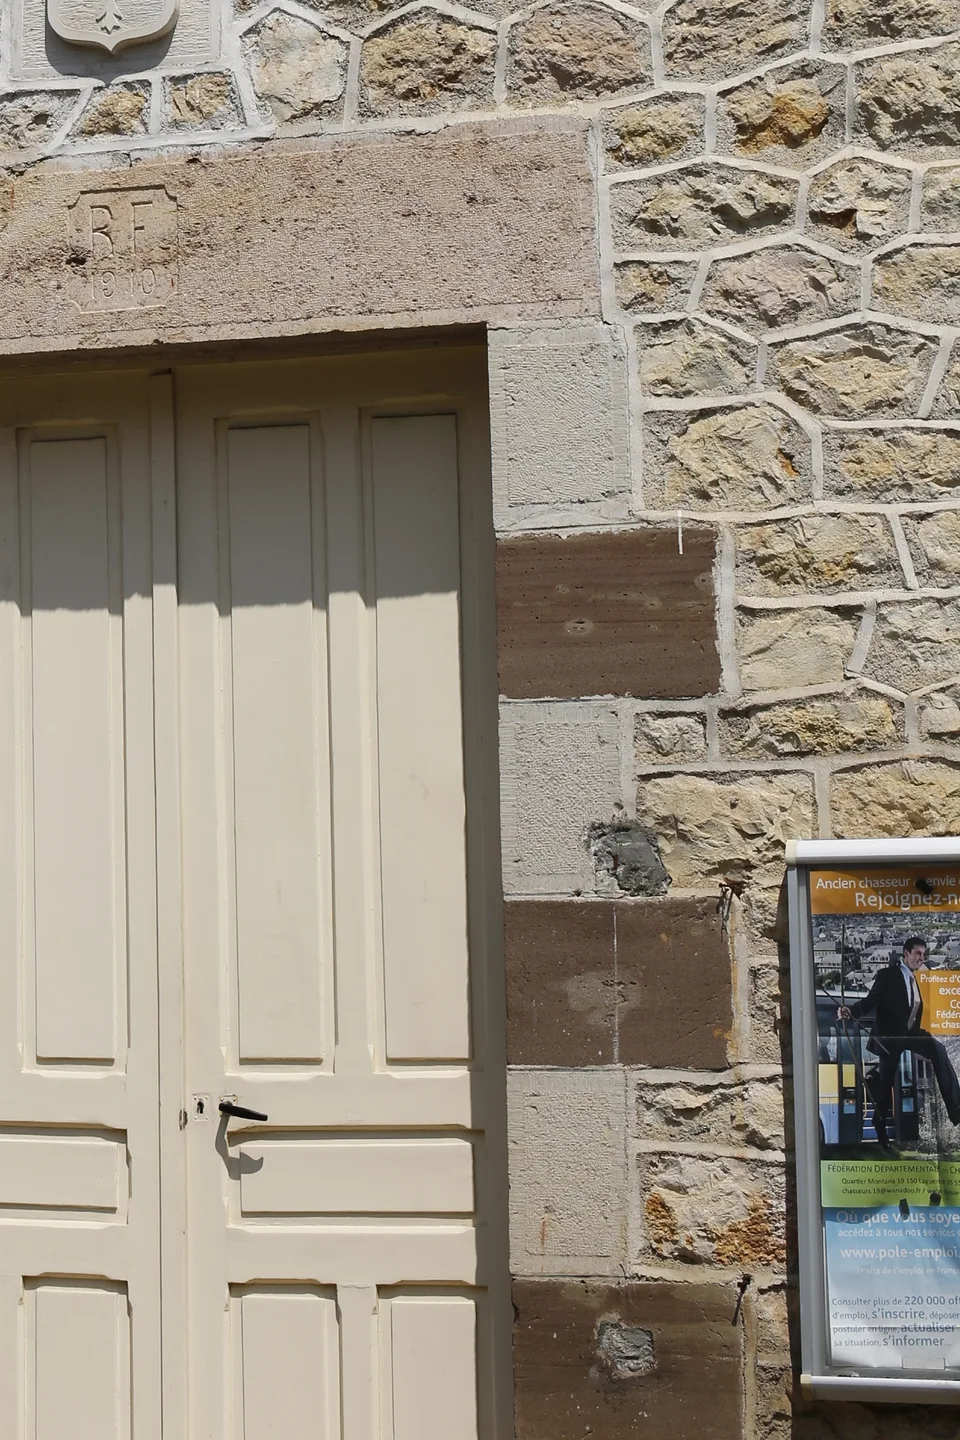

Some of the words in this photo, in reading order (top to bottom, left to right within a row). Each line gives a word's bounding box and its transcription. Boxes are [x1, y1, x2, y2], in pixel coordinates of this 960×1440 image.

[88, 201, 154, 258] RF
[816, 878, 856, 889] Ancien
[859, 877, 911, 889] chasseur
[926, 875, 956, 887] envie
[855, 892, 960, 910] Rejoignez-n
[920, 973, 948, 983] Profitez
[827, 1164, 872, 1173] FÉDÉRATION
[836, 1210, 858, 1224] Où
[862, 1213, 889, 1227] que
[838, 1228, 874, 1237] accédez
[876, 1228, 882, 1237] à
[883, 1229, 903, 1237] tous
[923, 1228, 955, 1237] services
[893, 1266, 925, 1276] l'emploi
[831, 1298, 872, 1306] Consulter
[873, 1298, 890, 1308] plus
[892, 1298, 902, 1306] de
[904, 1295, 924, 1306] 220
[926, 1295, 947, 1306] 000
[832, 1311, 870, 1320] d'emploi,
[871, 1308, 928, 1320] s'inscrire,
[929, 1311, 960, 1320] déposer
[833, 1326, 866, 1335] postuler
[879, 1325, 900, 1335] ligne,
[901, 1321, 956, 1333] actualiser
[844, 1338, 881, 1348] situation,
